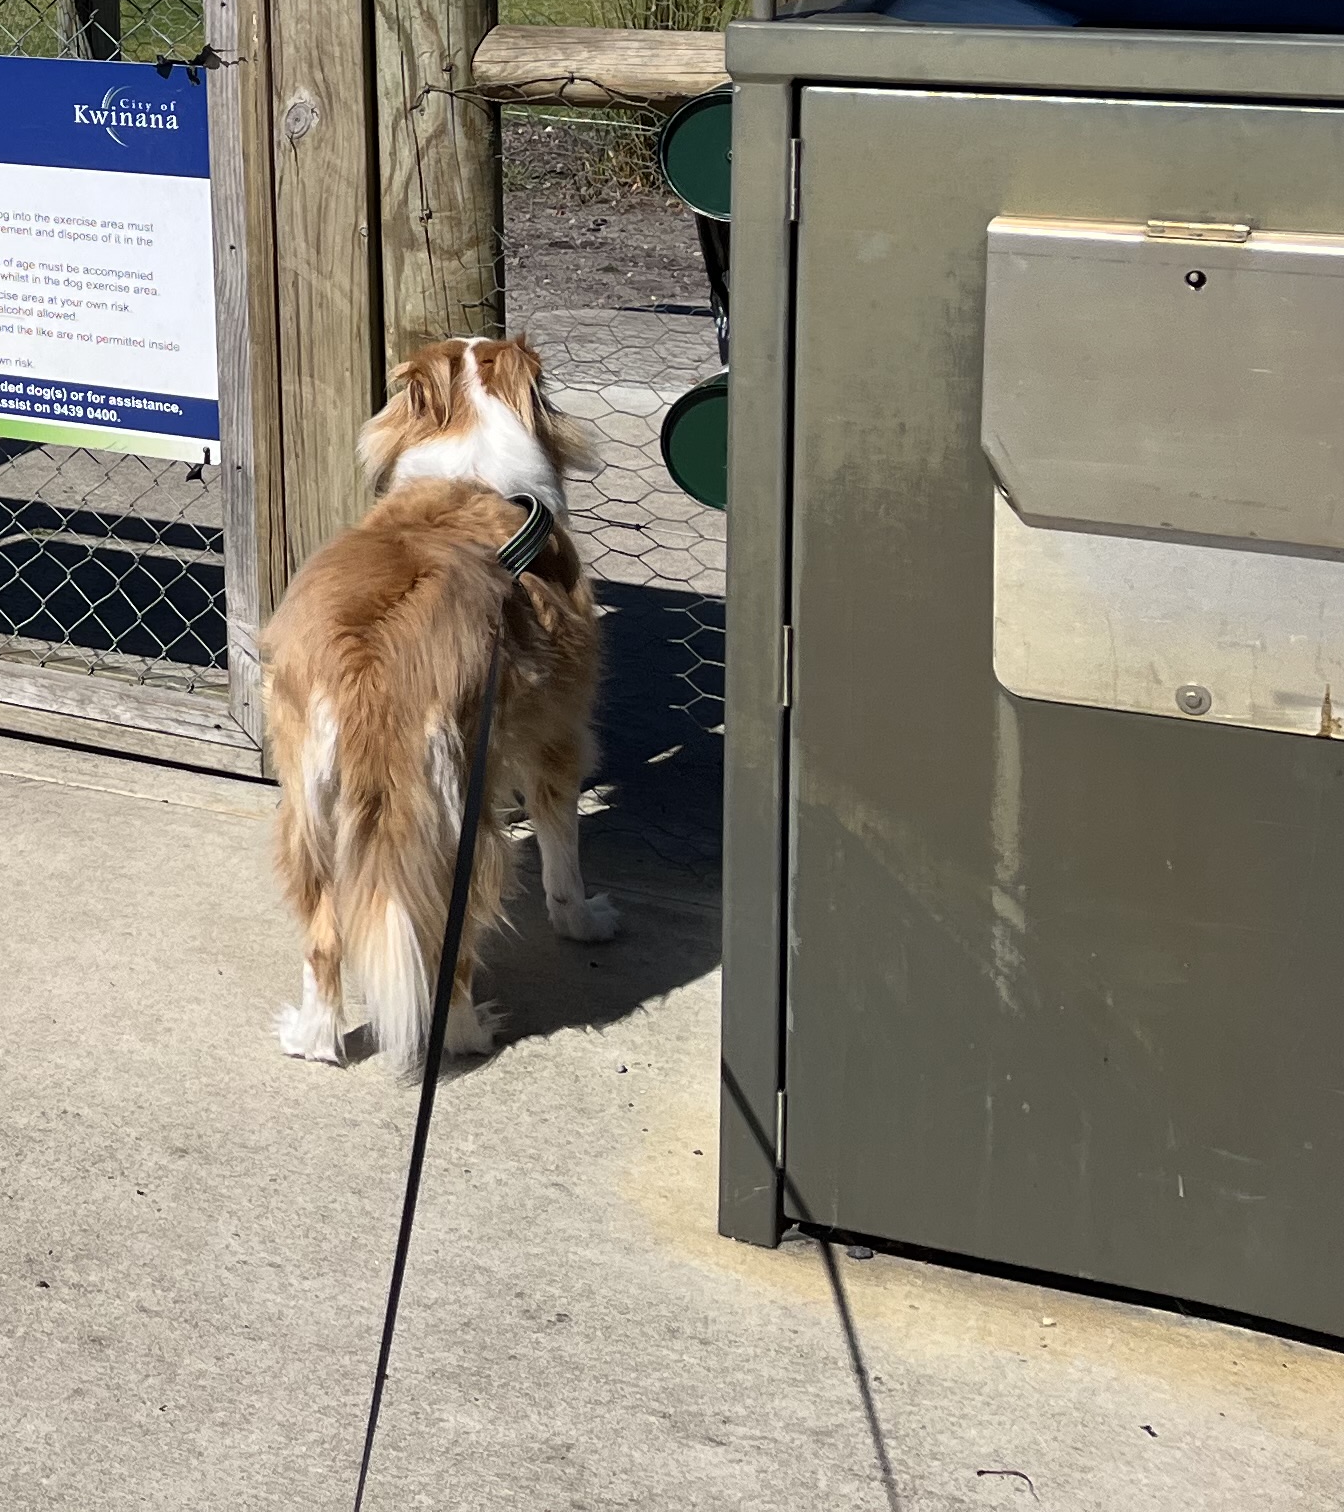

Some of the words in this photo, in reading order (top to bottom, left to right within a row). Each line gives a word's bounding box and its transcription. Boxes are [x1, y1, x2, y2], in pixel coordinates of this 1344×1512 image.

[73, 103, 179, 130] Kwinana
[119, 98, 152, 113] City
[159, 100, 177, 112] of
[11, 211, 32, 222] into
[33, 212, 51, 224] the
[52, 215, 98, 228] exercise
[99, 219, 125, 230] area
[126, 222, 154, 233] must
[34, 227, 55, 238] and
[56, 228, 98, 243] dispose
[100, 232, 113, 243] of
[113, 233, 122, 245] it
[123, 236, 134, 246] in
[135, 235, 154, 247] the
[2, 256, 14, 268] of
[15, 259, 36, 272] age
[37, 261, 64, 273] must
[65, 262, 80, 274] be
[81, 266, 154, 281] accompanied
[0, 271, 30, 284] whilst
[31, 275, 41, 285] in
[42, 274, 61, 287] the
[62, 276, 83, 291] dog
[84, 280, 130, 294] exercise
[20, 293, 45, 304] area
[46, 295, 58, 306] at
[59, 297, 84, 309] your
[84, 300, 108, 310] own
[16, 324, 34, 336] the
[35, 326, 54, 338] like
[55, 330, 74, 341] are
[75, 332, 94, 343] not
[95, 334, 146, 349] permitted
[148, 340, 180, 352] inside
[25, 383, 68, 402] dog(s)
[69, 390, 85, 402] or
[86, 390, 106, 404] for
[108, 395, 183, 416] assistance,
[33, 402, 51, 414] on
[52, 402, 84, 418] 9439
[85, 406, 121, 423] 0400.
